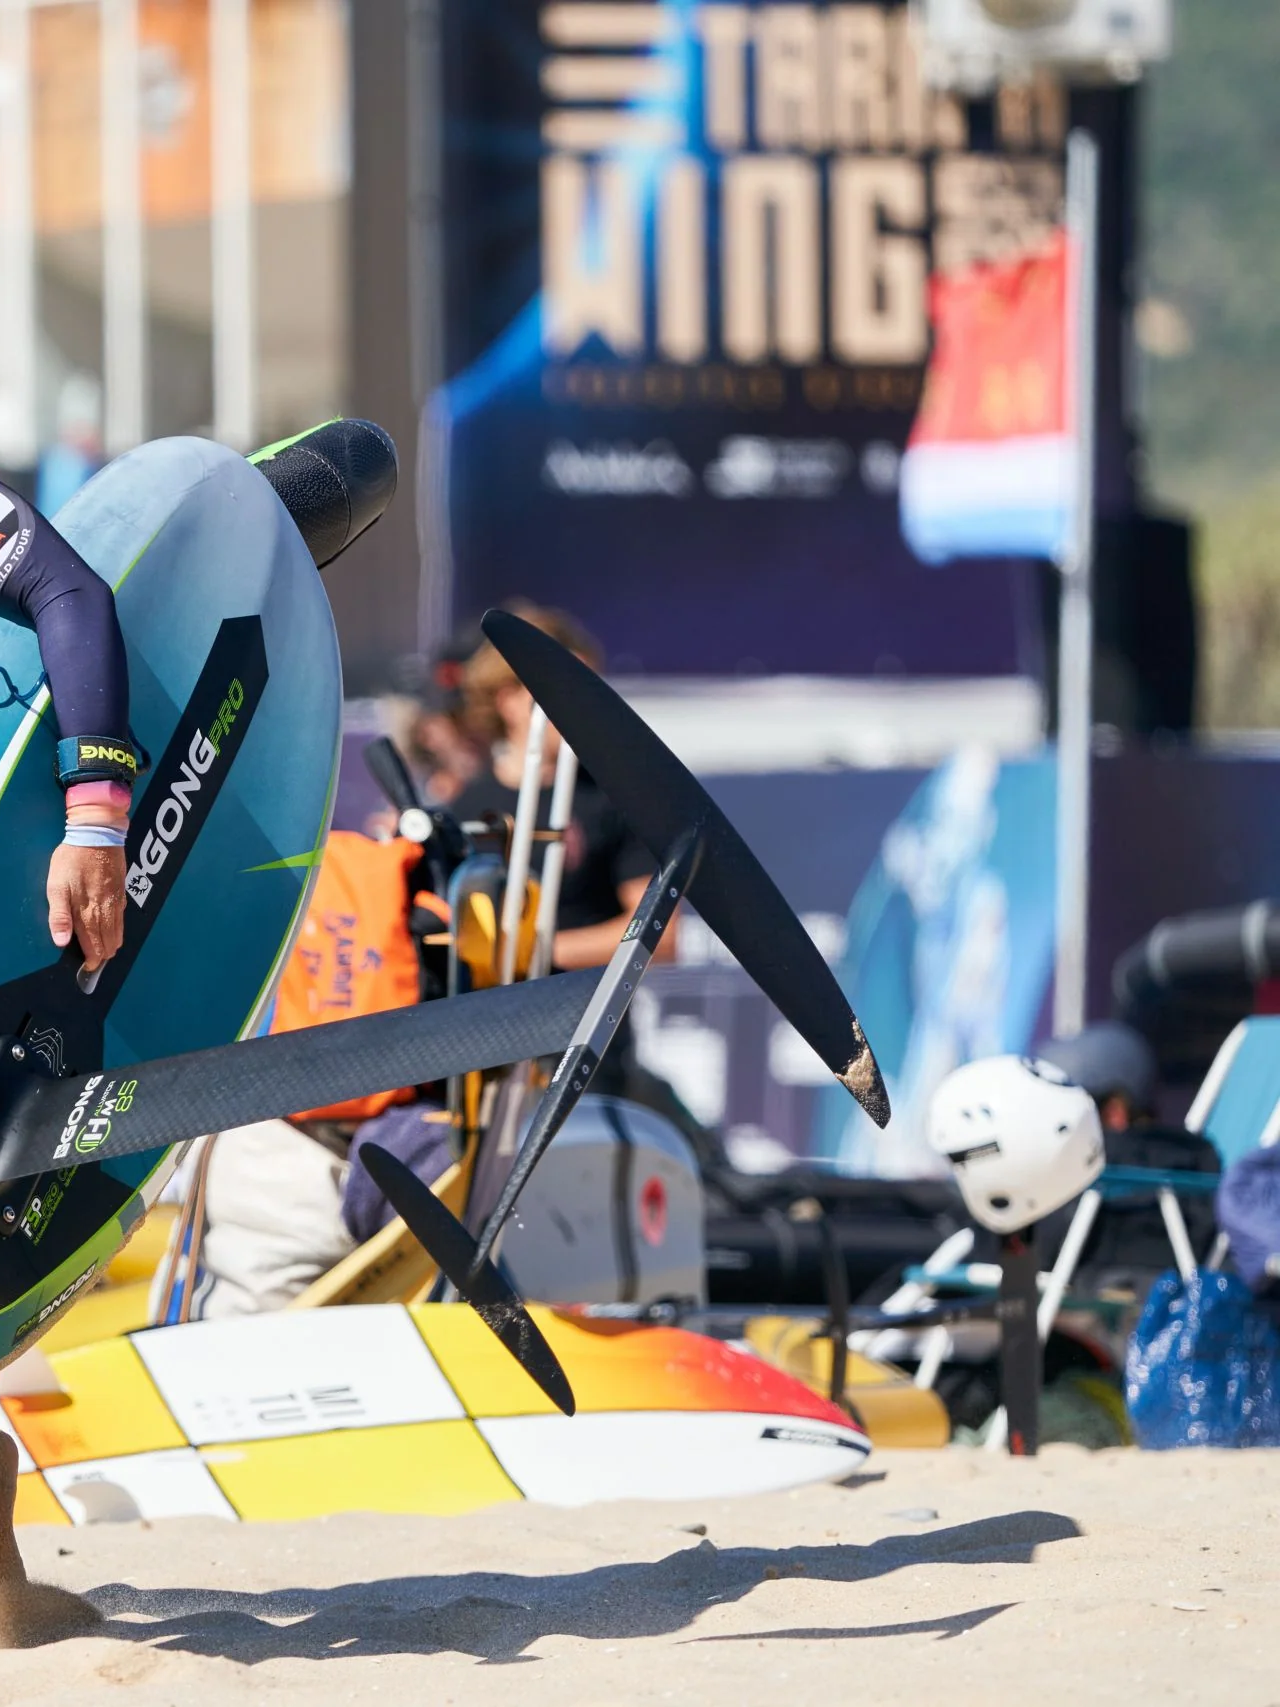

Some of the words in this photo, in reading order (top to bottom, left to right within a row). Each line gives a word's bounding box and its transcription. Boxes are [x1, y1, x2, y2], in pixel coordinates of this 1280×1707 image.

[696, 2, 1067, 150] TARI
[541, 156, 928, 365] WING
[11, 528, 31, 561] TOUR
[80, 745, 136, 770] GONG
[139, 727, 217, 876] GONG
[207, 678, 244, 757] PRO
[60, 1075, 104, 1144] GONG
[115, 1080, 138, 1112] 85
[38, 1275, 89, 1323] GONG
